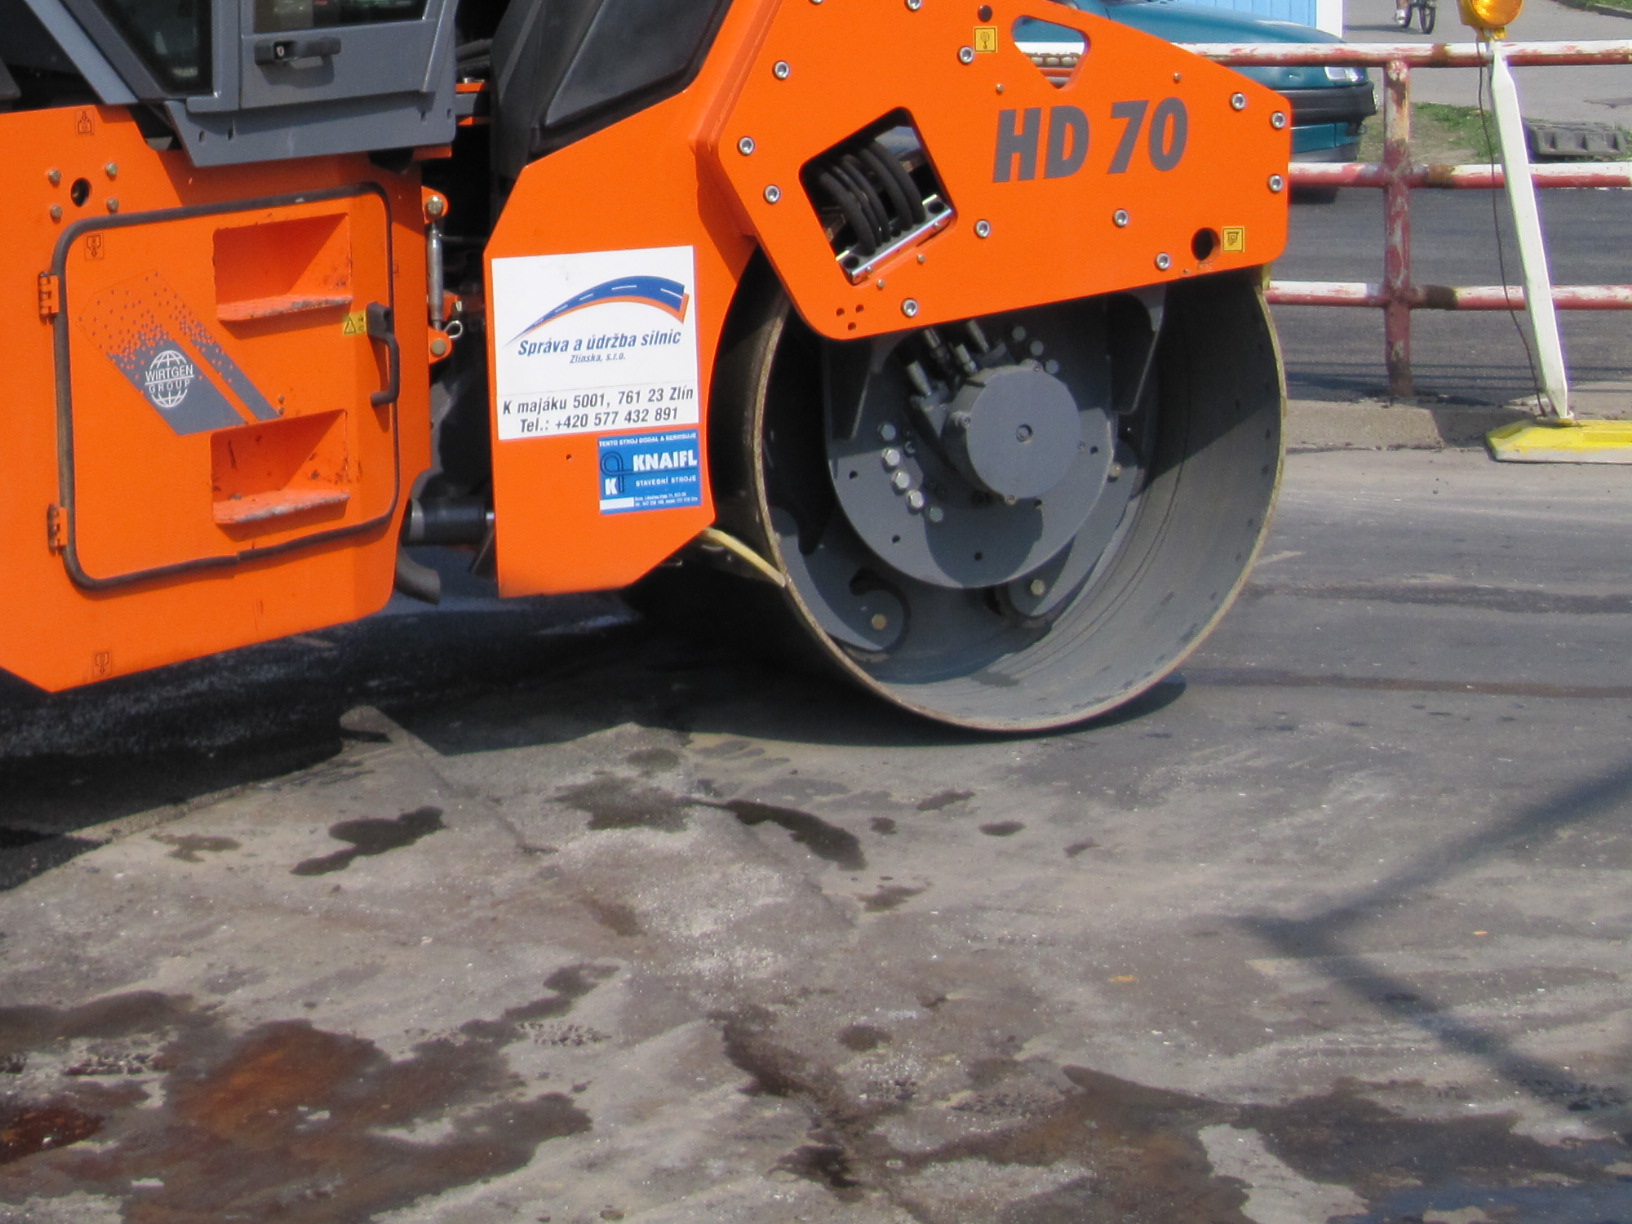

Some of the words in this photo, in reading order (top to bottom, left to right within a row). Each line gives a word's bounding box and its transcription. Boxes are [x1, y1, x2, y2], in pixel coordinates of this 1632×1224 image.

[993, 105, 1090, 183] HD
[1107, 97, 1188, 174] 70
[518, 337, 570, 357] Správa
[573, 338, 583, 352] a
[586, 332, 637, 350] údržba
[640, 328, 682, 346] silnic
[145, 364, 193, 383] WIRTGEN
[148, 378, 191, 393] GROUP
[502, 400, 512, 416] K
[518, 395, 567, 415] majáku
[573, 392, 611, 409] 5001,
[618, 390, 641, 405] 761
[648, 388, 664, 403] 23
[669, 385, 694, 401] Zlín
[520, 419, 550, 433] Tel.:
[555, 413, 588, 430] +420
[594, 411, 619, 426] 577
[624, 408, 649, 424] 432
[655, 406, 679, 421] 891
[633, 450, 698, 472] KNAIFL
[605, 477, 618, 495] K
